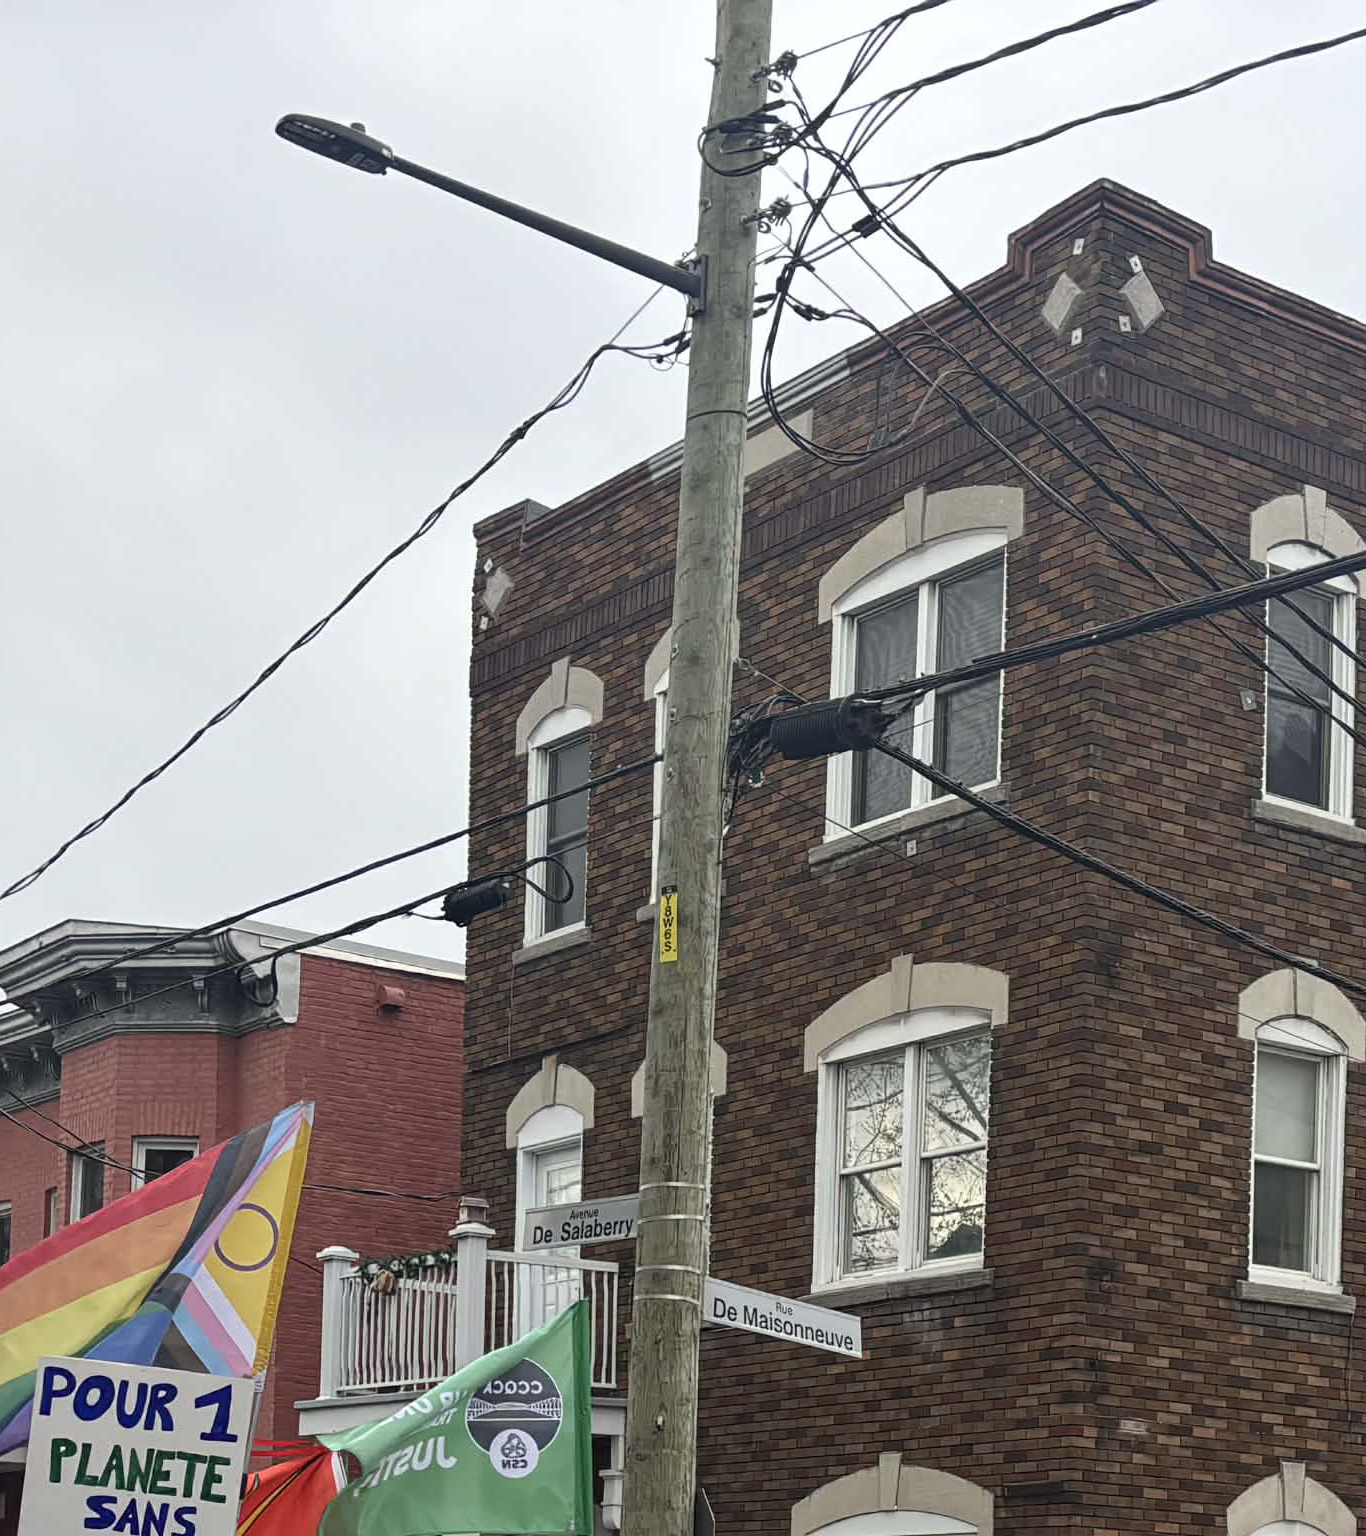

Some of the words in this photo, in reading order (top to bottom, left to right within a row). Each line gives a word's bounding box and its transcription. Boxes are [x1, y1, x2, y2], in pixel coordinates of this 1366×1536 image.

[532, 1226, 553, 1245] De
[561, 1218, 635, 1242] Salaberry
[569, 1208, 600, 1220] Avenue
[713, 1297, 738, 1322] De
[743, 1305, 854, 1351] Maisonneuve
[776, 1302, 793, 1316] Rue
[39, 1366, 178, 1431] POUR
[195, 1384, 238, 1442] 1
[49, 1438, 231, 1503] PLANETE
